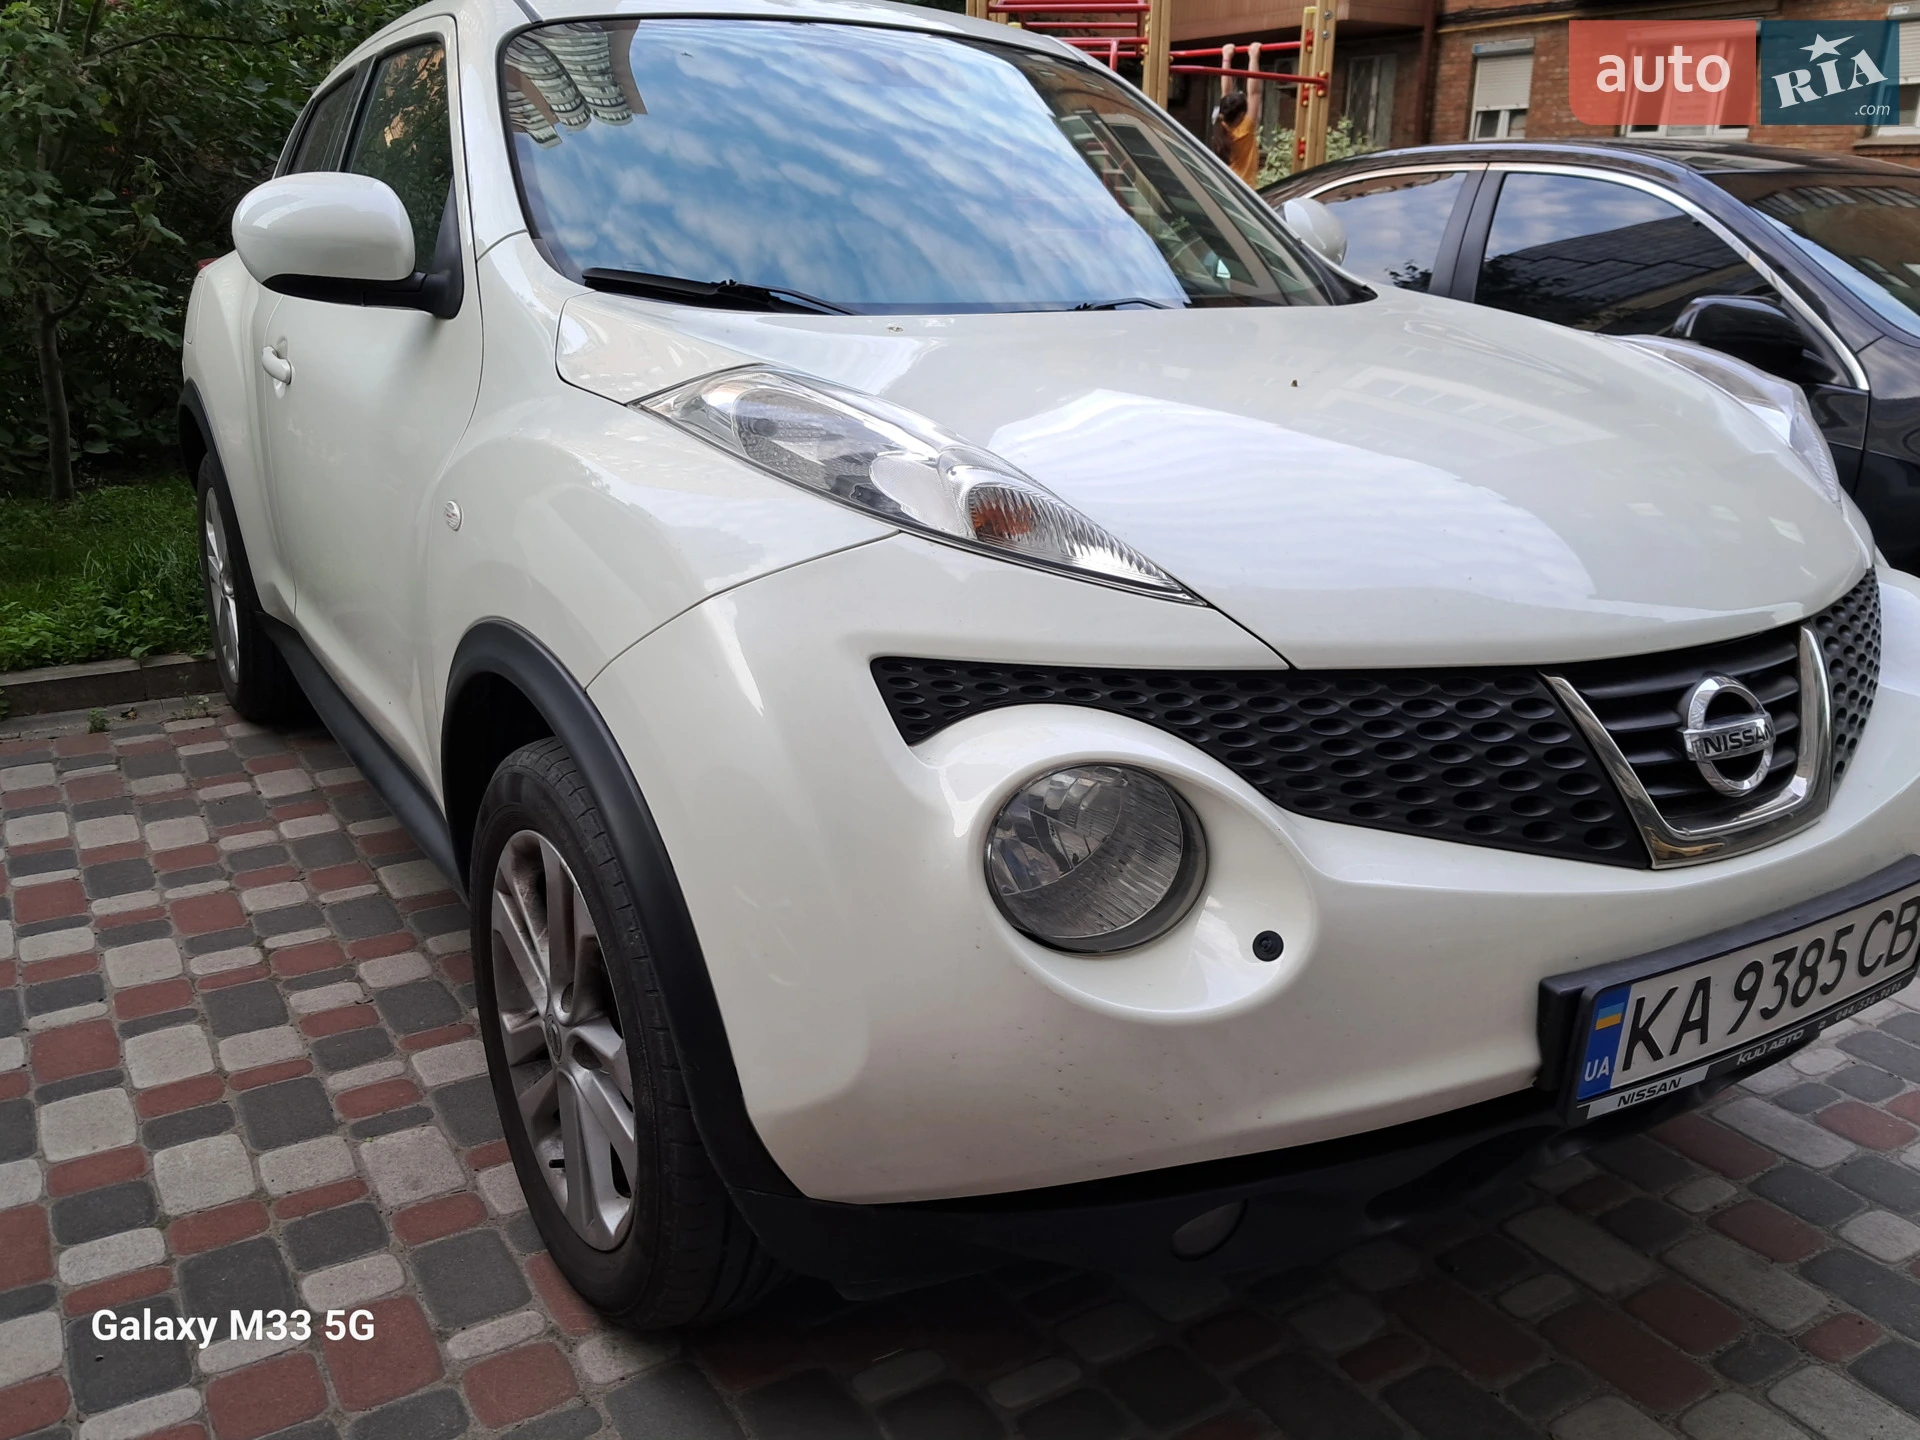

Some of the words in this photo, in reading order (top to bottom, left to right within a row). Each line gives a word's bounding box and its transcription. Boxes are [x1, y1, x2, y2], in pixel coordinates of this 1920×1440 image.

[1702, 723, 1775, 755] NISSAN
[1622, 976, 1712, 1072] KA
[1727, 924, 1855, 1036] 9385
[1857, 895, 1920, 978] CB
[1583, 1055, 1611, 1083] UA
[1617, 1076, 1682, 1108] NISSAN
